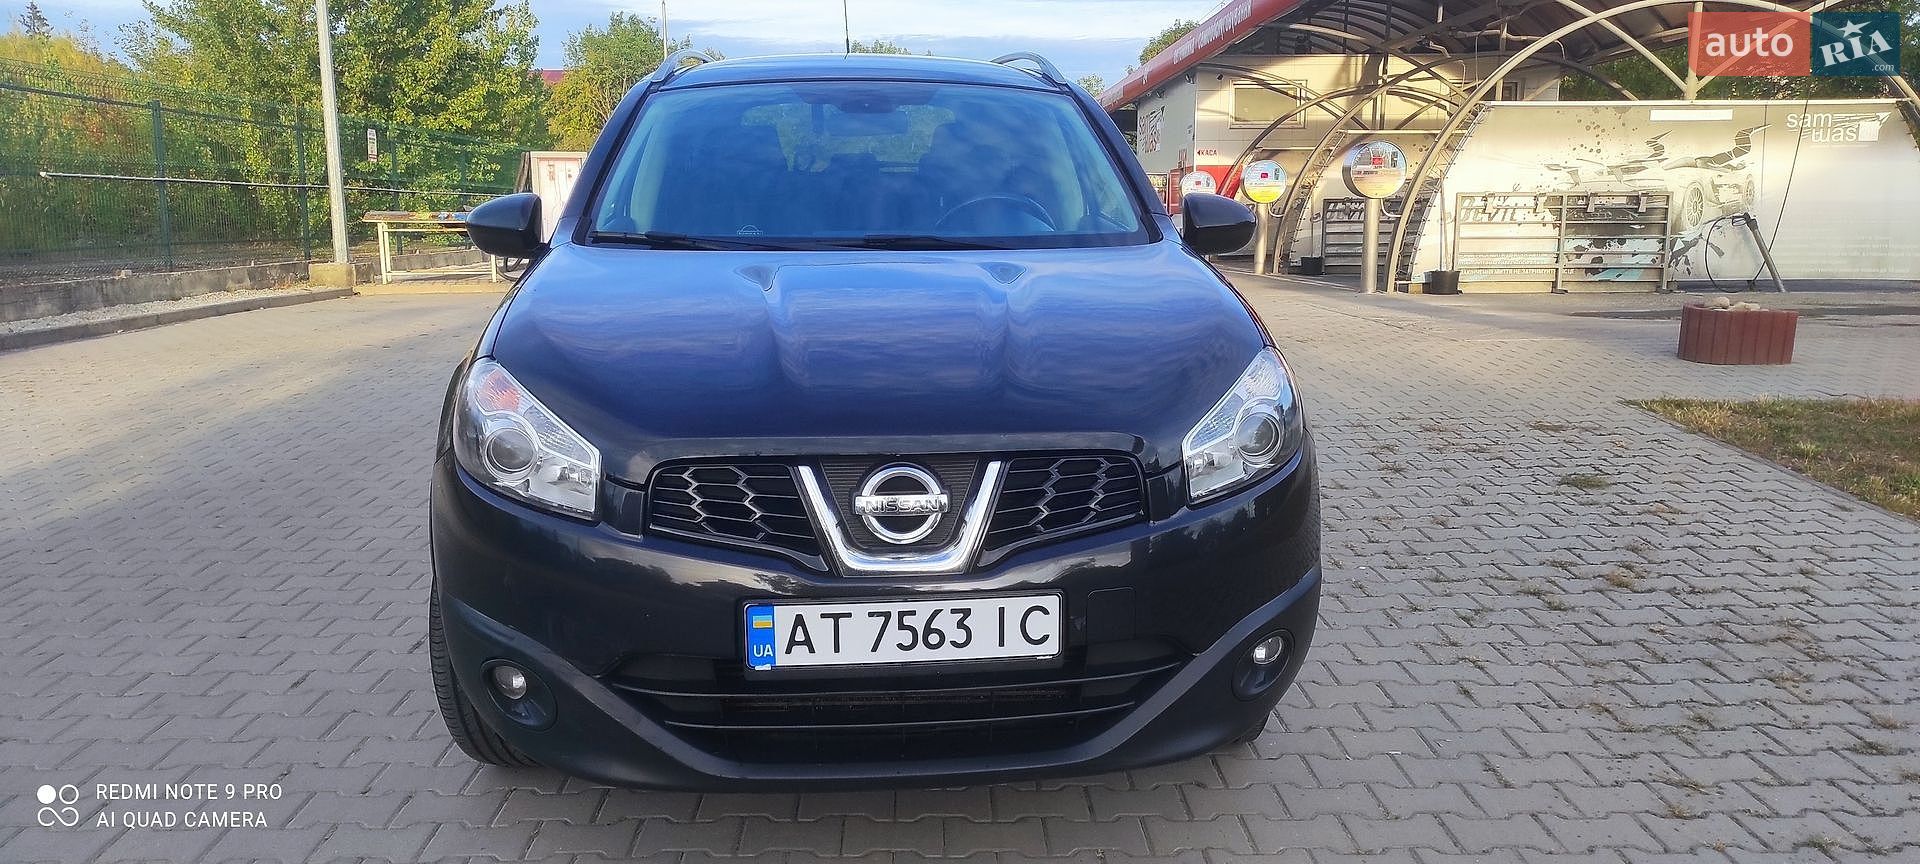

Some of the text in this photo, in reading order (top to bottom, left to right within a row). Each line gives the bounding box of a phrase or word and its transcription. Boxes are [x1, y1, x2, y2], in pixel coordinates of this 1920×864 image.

[864, 499, 939, 513] NISSAN
[753, 605, 1051, 658] UA AT 7563 IC
